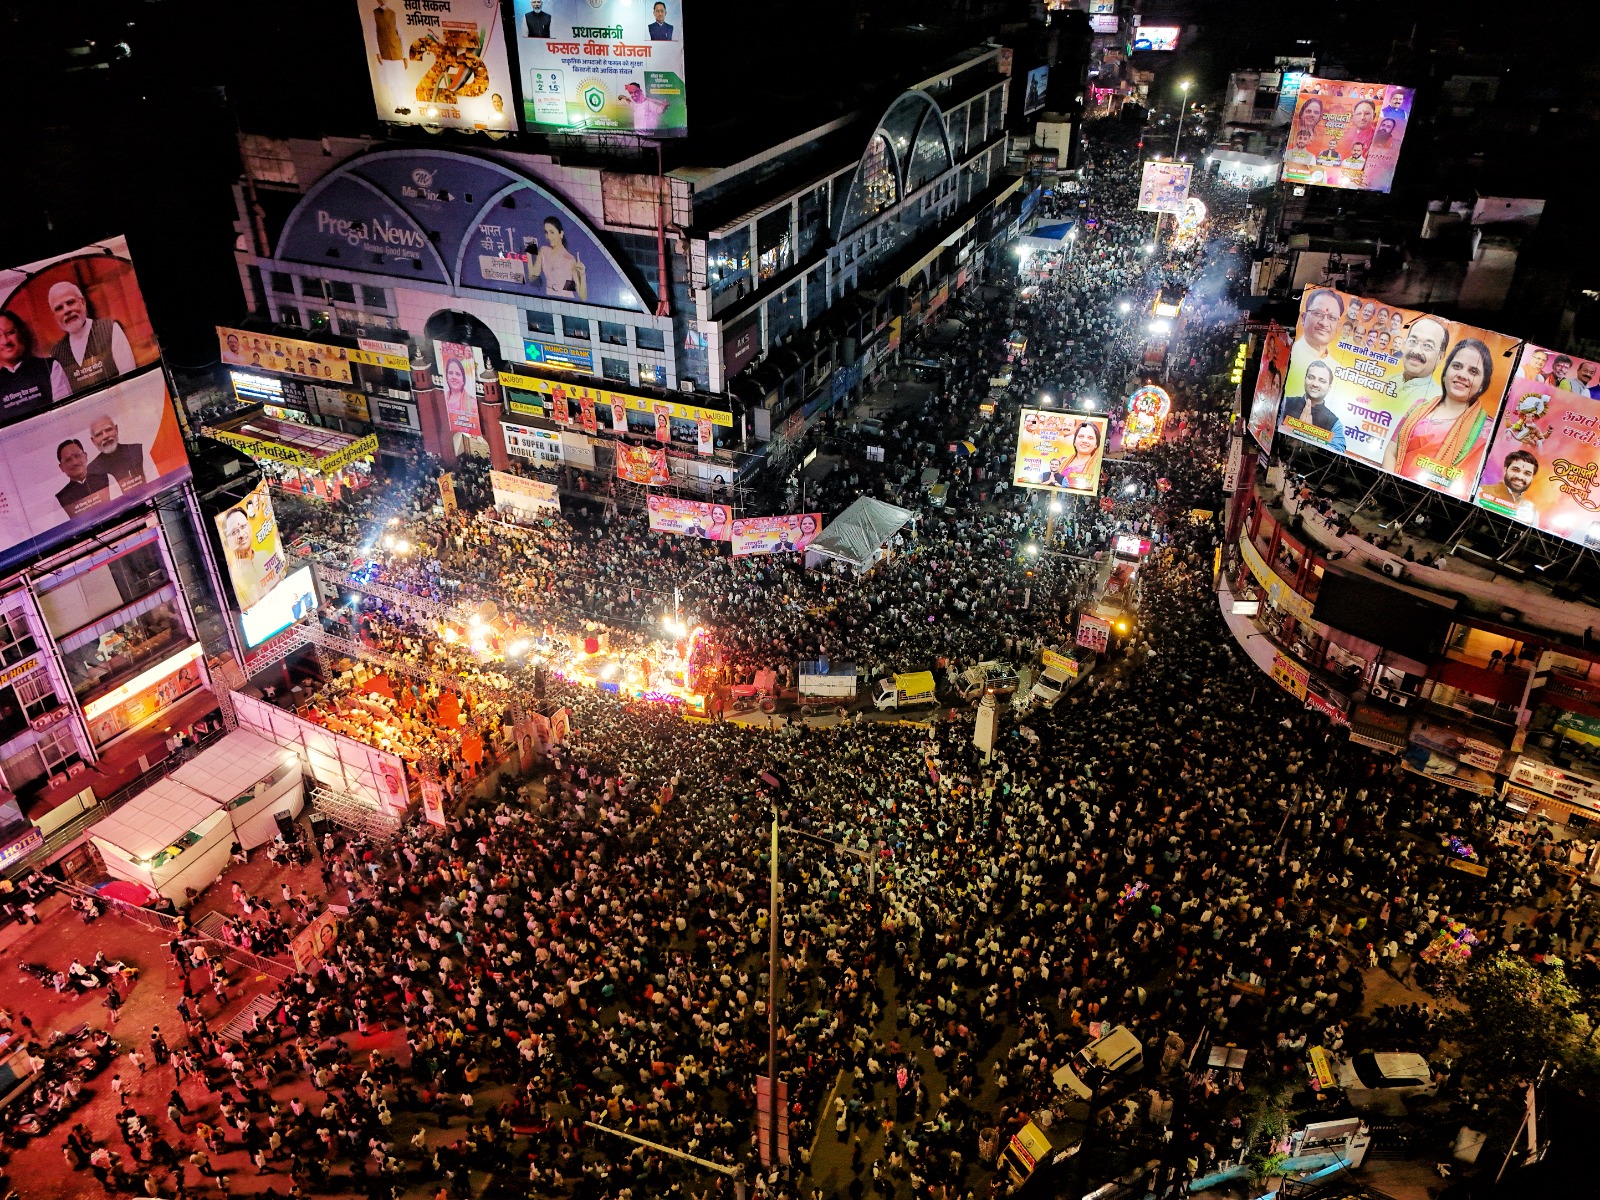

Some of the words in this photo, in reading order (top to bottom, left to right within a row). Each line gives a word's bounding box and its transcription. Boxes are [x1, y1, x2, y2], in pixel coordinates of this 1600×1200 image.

[406, 11, 440, 27] अभियान
[572, 25, 623, 39] प्रधानमंत्री
[546, 42, 580, 55] फसल
[583, 40, 609, 57] बीमा
[613, 42, 652, 58] योजना
[318, 210, 369, 246] Prega
[373, 218, 425, 249] News
[479, 224, 501, 237] भारत
[481, 236, 494, 251] की
[1338, 341, 1352, 350] आप
[1353, 345, 1369, 356] सभी
[1369, 351, 1387, 361] भक्तों
[1387, 355, 1399, 365] का
[1355, 359, 1386, 377] हार्दिक
[1335, 367, 1386, 393] अभिनंदन
[1347, 403, 1392, 427] गणपति
[1563, 411, 1598, 428] अगले
[1361, 420, 1389, 438] बप्पा
[1563, 426, 1596, 444] जल्दी
[522, 439, 545, 450] SUPER
[511, 446, 537, 458] MOBILE
[540, 452, 559, 462] SHOP
[10, 657, 38, 678] HOTEL
[4, 832, 38, 857] HOTEL
